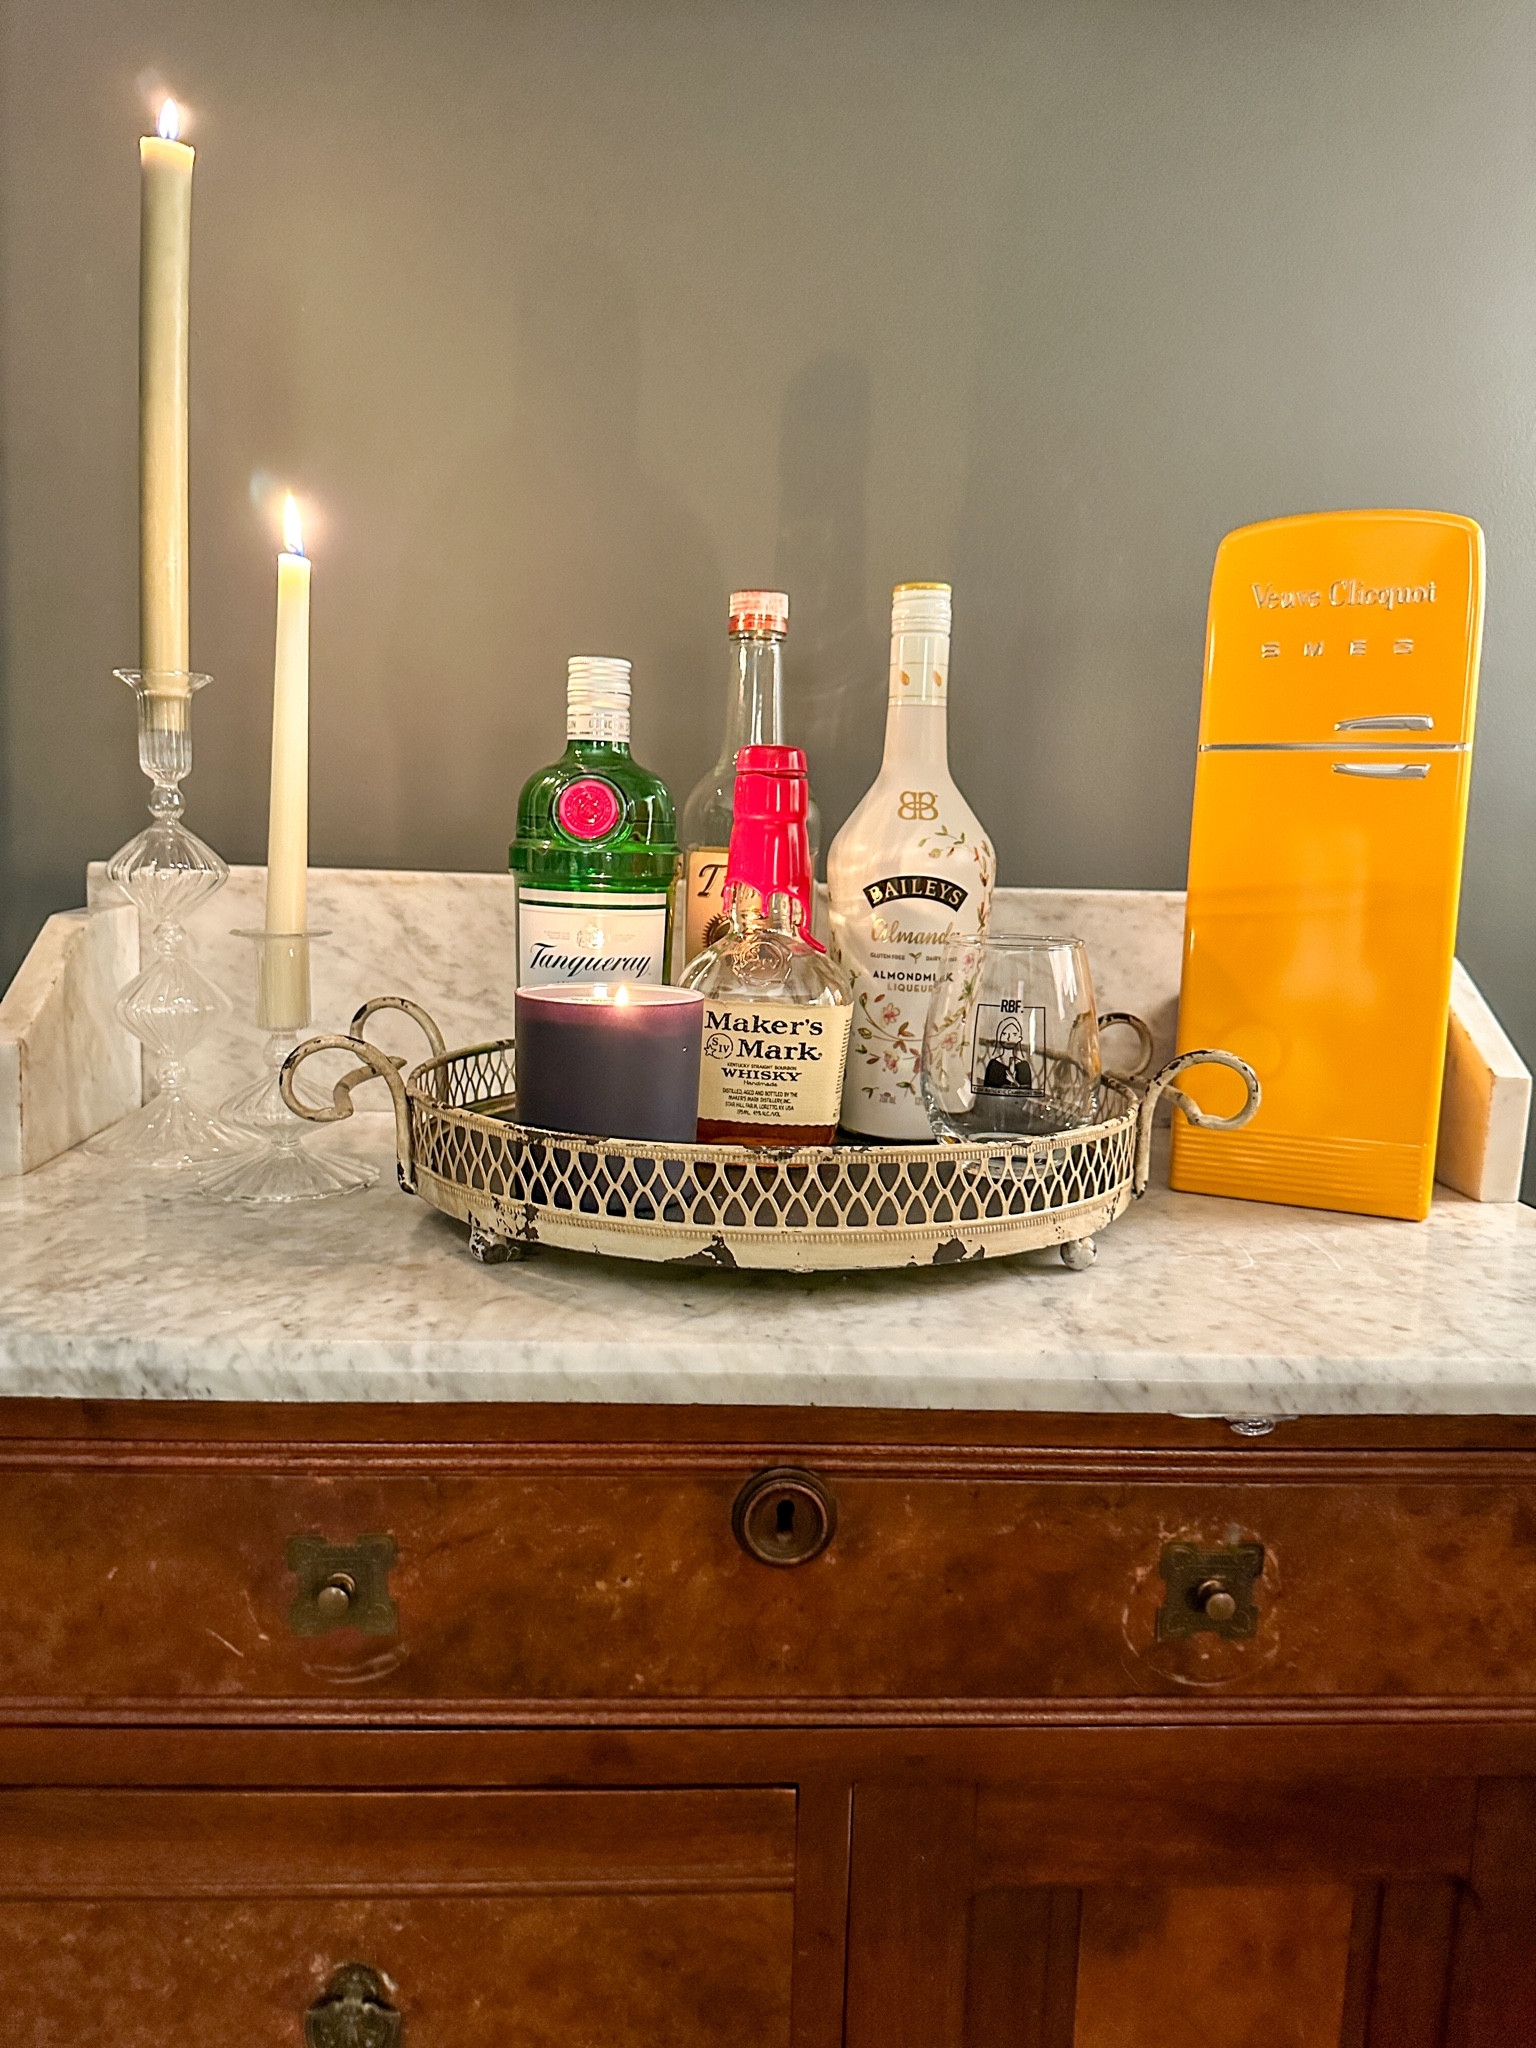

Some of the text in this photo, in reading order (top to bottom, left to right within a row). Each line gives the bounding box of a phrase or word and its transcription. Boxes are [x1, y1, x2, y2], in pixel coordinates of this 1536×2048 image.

[1251, 579, 1437, 611] Veuve Clicquot
[868, 879, 962, 905] BAILEYS
[530, 942, 652, 979] Tanqueray
[870, 951, 891, 959] GLUTEN
[872, 970, 954, 982] ALMONDMIK
[704, 1010, 823, 1036] Maker's
[736, 1038, 820, 1061] Mark
[721, 1067, 803, 1082] WHISKY
